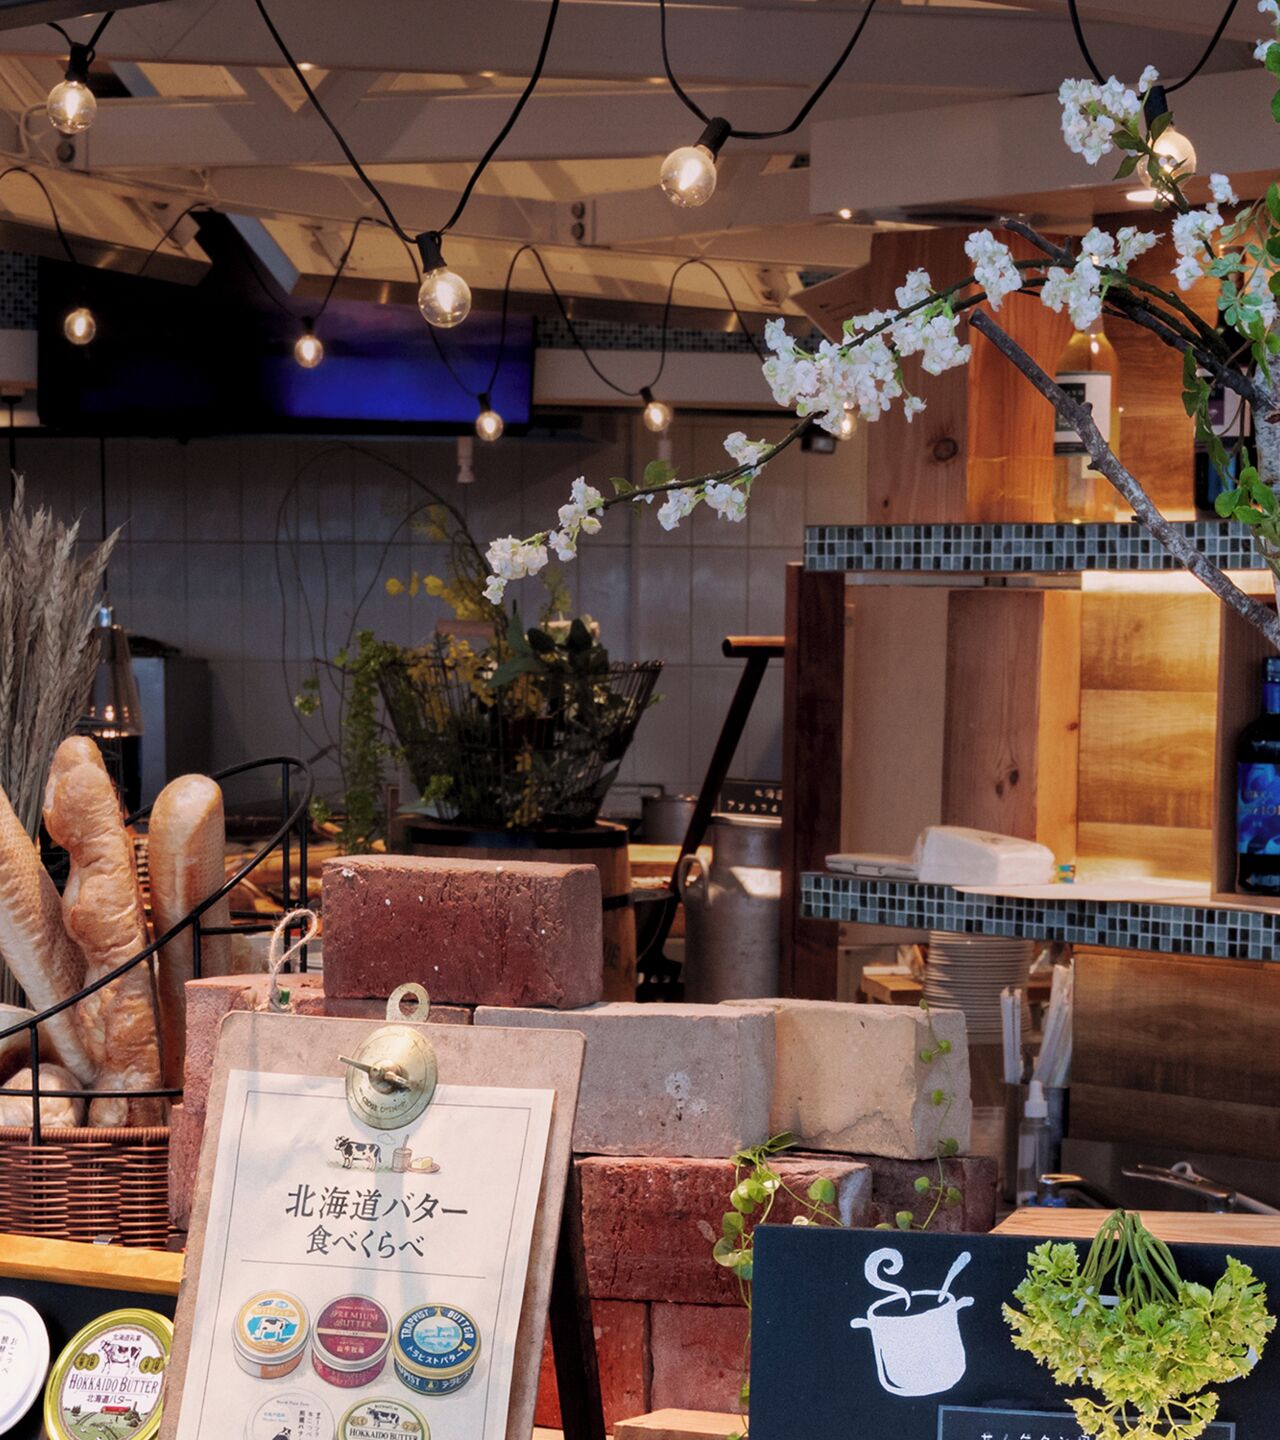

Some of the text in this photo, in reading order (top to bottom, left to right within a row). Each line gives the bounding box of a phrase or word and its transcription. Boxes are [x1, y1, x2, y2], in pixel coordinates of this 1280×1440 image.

[285, 1183, 468, 1223] 北海道バター
[306, 1224, 425, 1260] 食べくらべ
[329, 1309, 379, 1322] PREMIUM
[401, 1309, 474, 1340] TRAPPIST BUTTER
[69, 1373, 159, 1395] HOKKAIDO BUTTER
[86, 1394, 132, 1405] 北海道バター
[349, 1427, 389, 1440] HOKKAIDO
